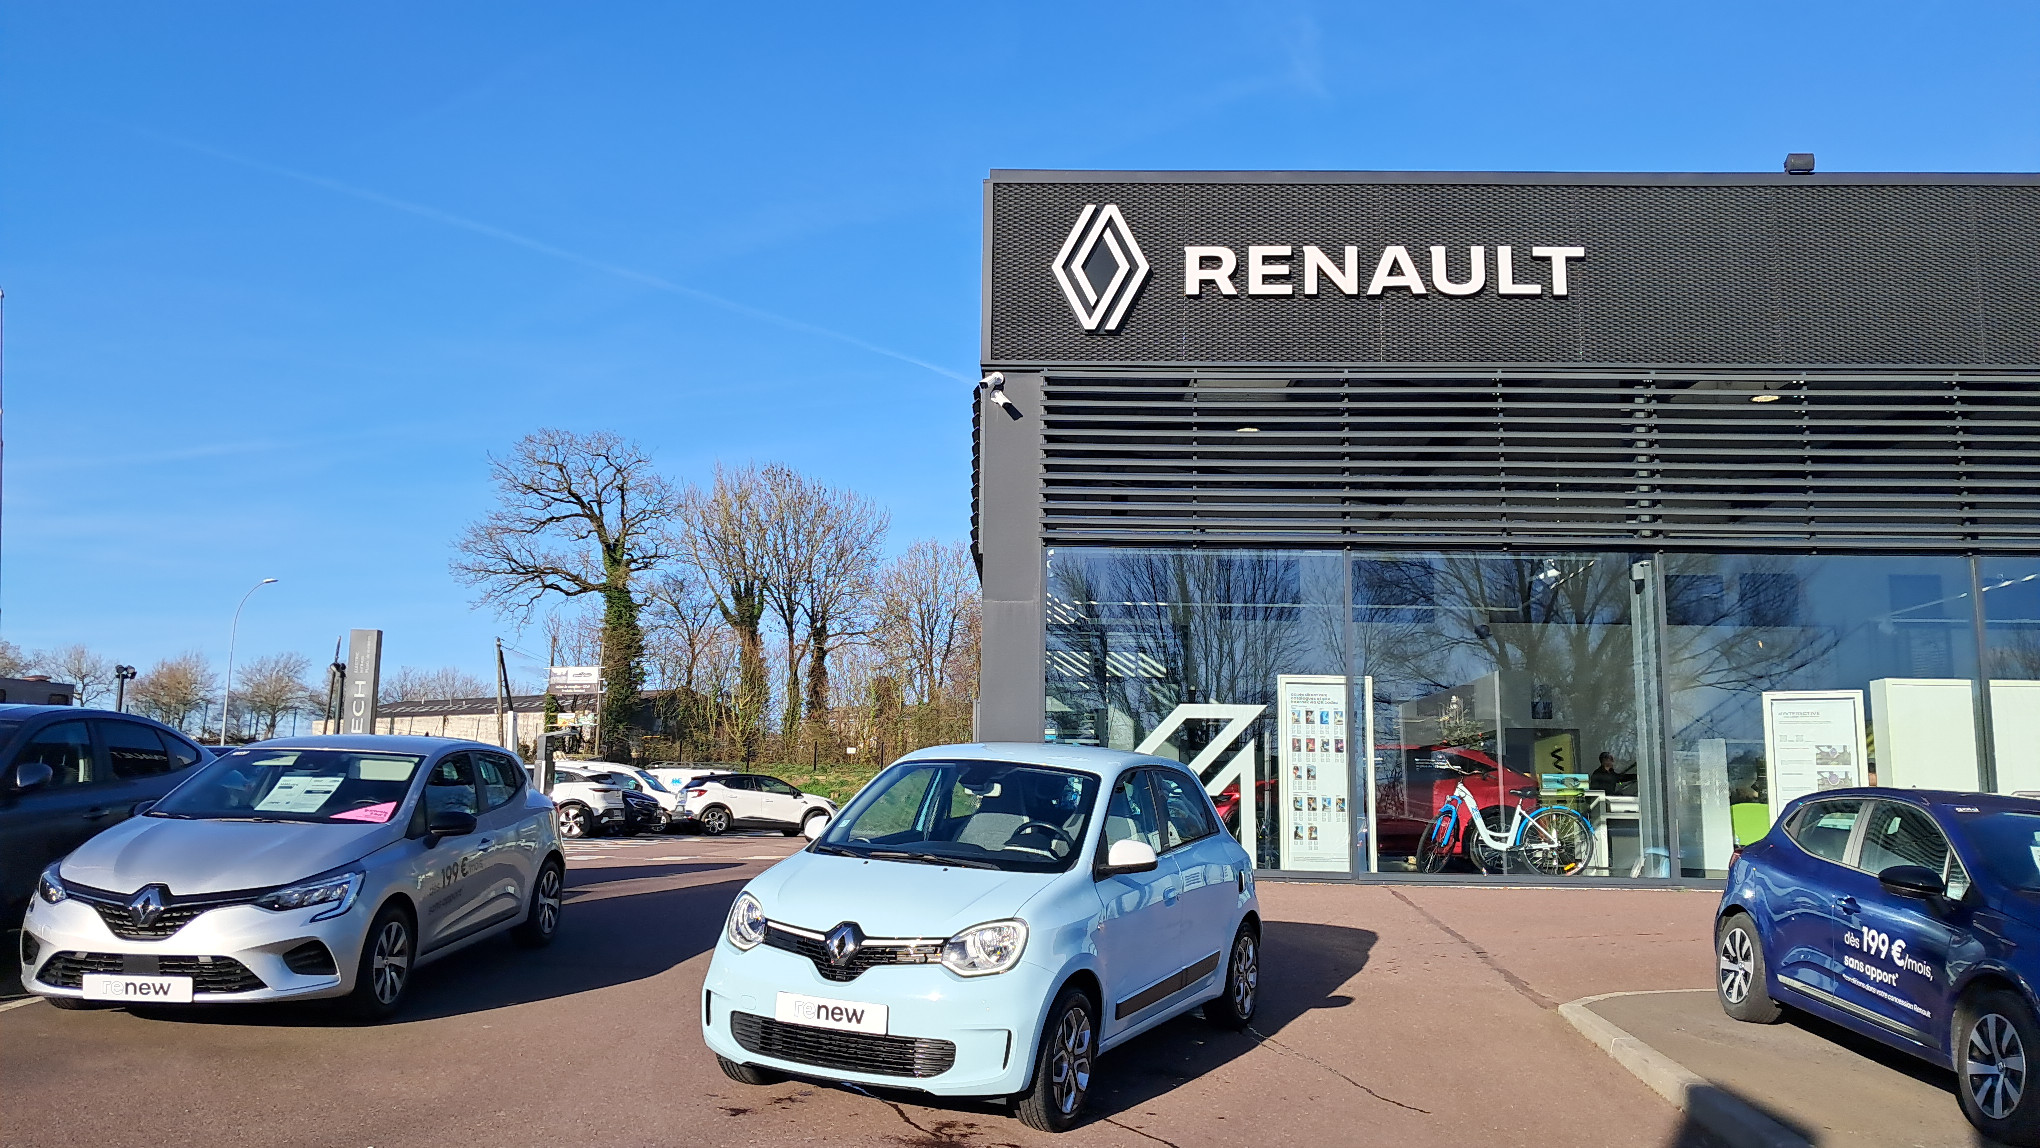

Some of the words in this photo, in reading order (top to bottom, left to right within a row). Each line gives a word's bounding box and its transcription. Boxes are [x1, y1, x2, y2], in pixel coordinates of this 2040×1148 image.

[1184, 245, 1585, 296] RENAULT
[441, 861, 459, 889] 199
[1844, 931, 1860, 949] dès
[1862, 925, 1889, 960] 199
[1844, 955, 1865, 973] sans
[102, 980, 172, 996] renew
[794, 1000, 865, 1025] renew
